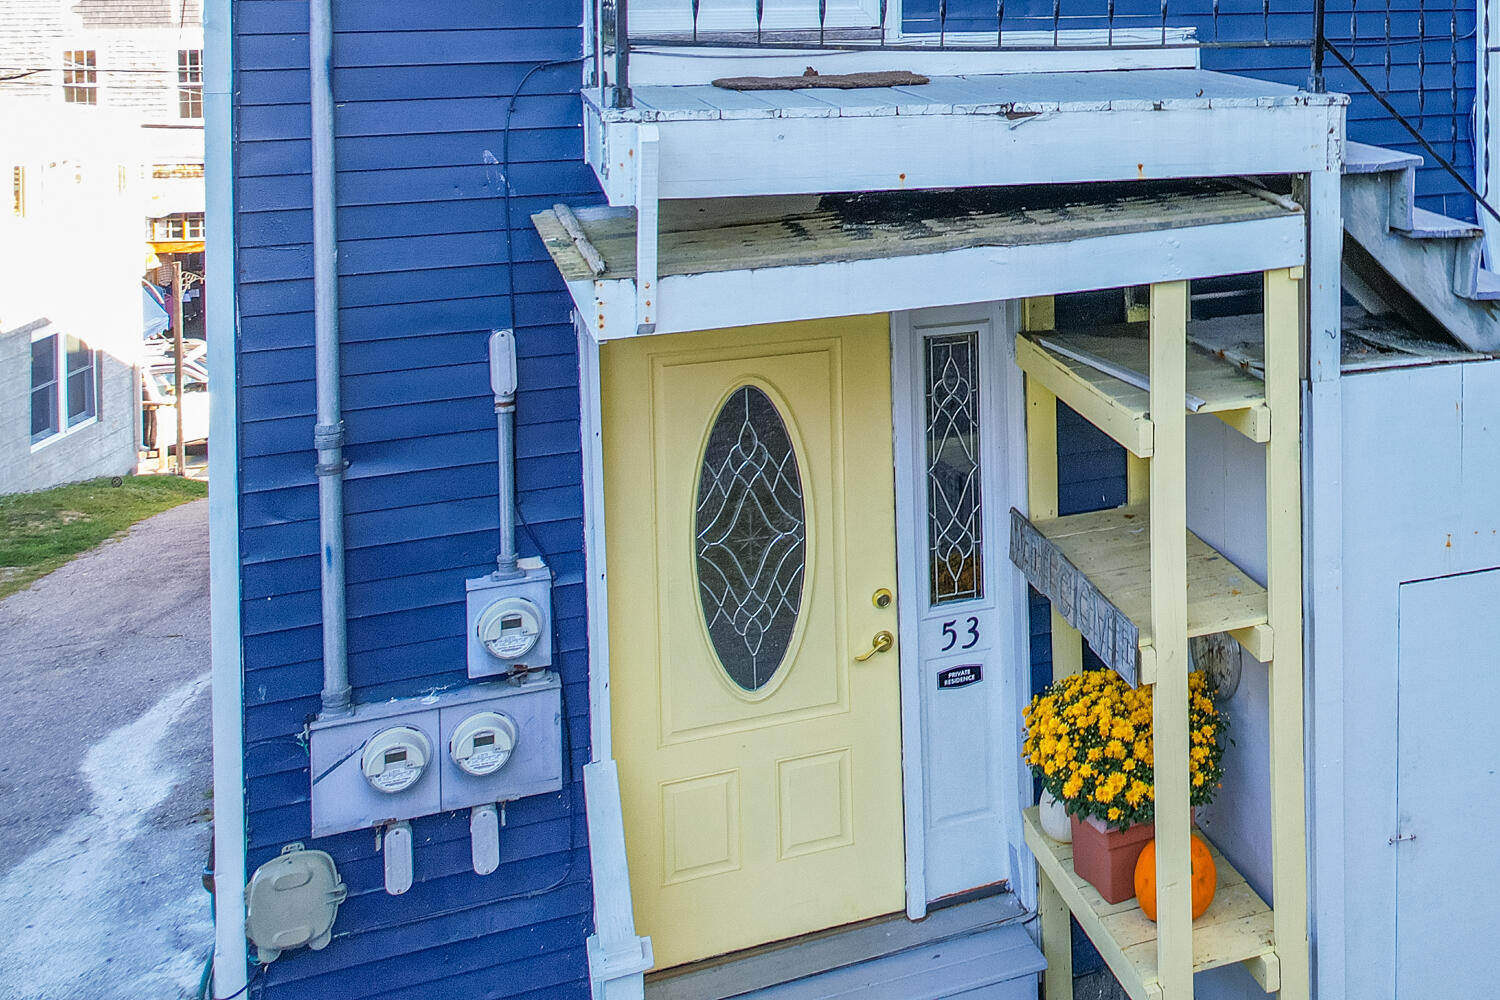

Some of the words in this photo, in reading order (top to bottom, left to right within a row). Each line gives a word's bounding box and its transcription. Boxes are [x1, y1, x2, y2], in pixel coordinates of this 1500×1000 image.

[941, 616, 980, 652] 53
[948, 668, 971, 679] PRIVATE
[944, 674, 976, 687] RESIDENCE
